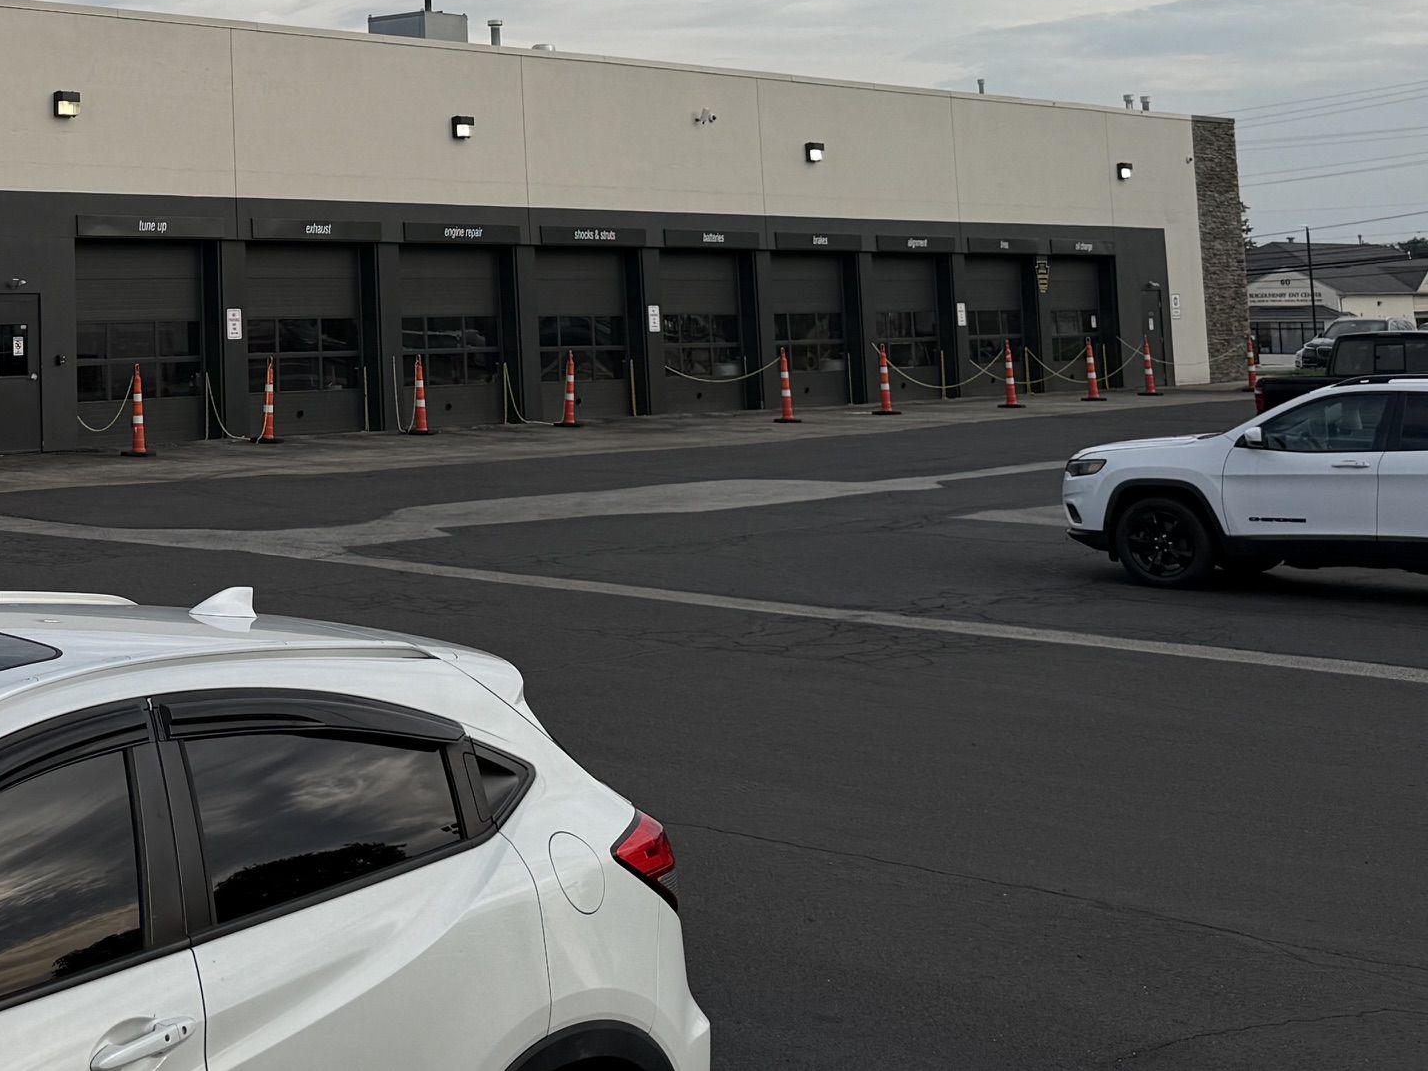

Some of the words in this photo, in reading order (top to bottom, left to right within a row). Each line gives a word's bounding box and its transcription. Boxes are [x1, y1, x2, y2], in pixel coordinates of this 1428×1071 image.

[139, 219, 156, 232] tune
[157, 221, 167, 234] up
[305, 223, 332, 235] exhaust
[444, 226, 464, 239] engine
[465, 227, 483, 238] repair
[574, 229, 594, 240] shocks
[594, 230, 600, 240] &
[600, 230, 616, 241] struts
